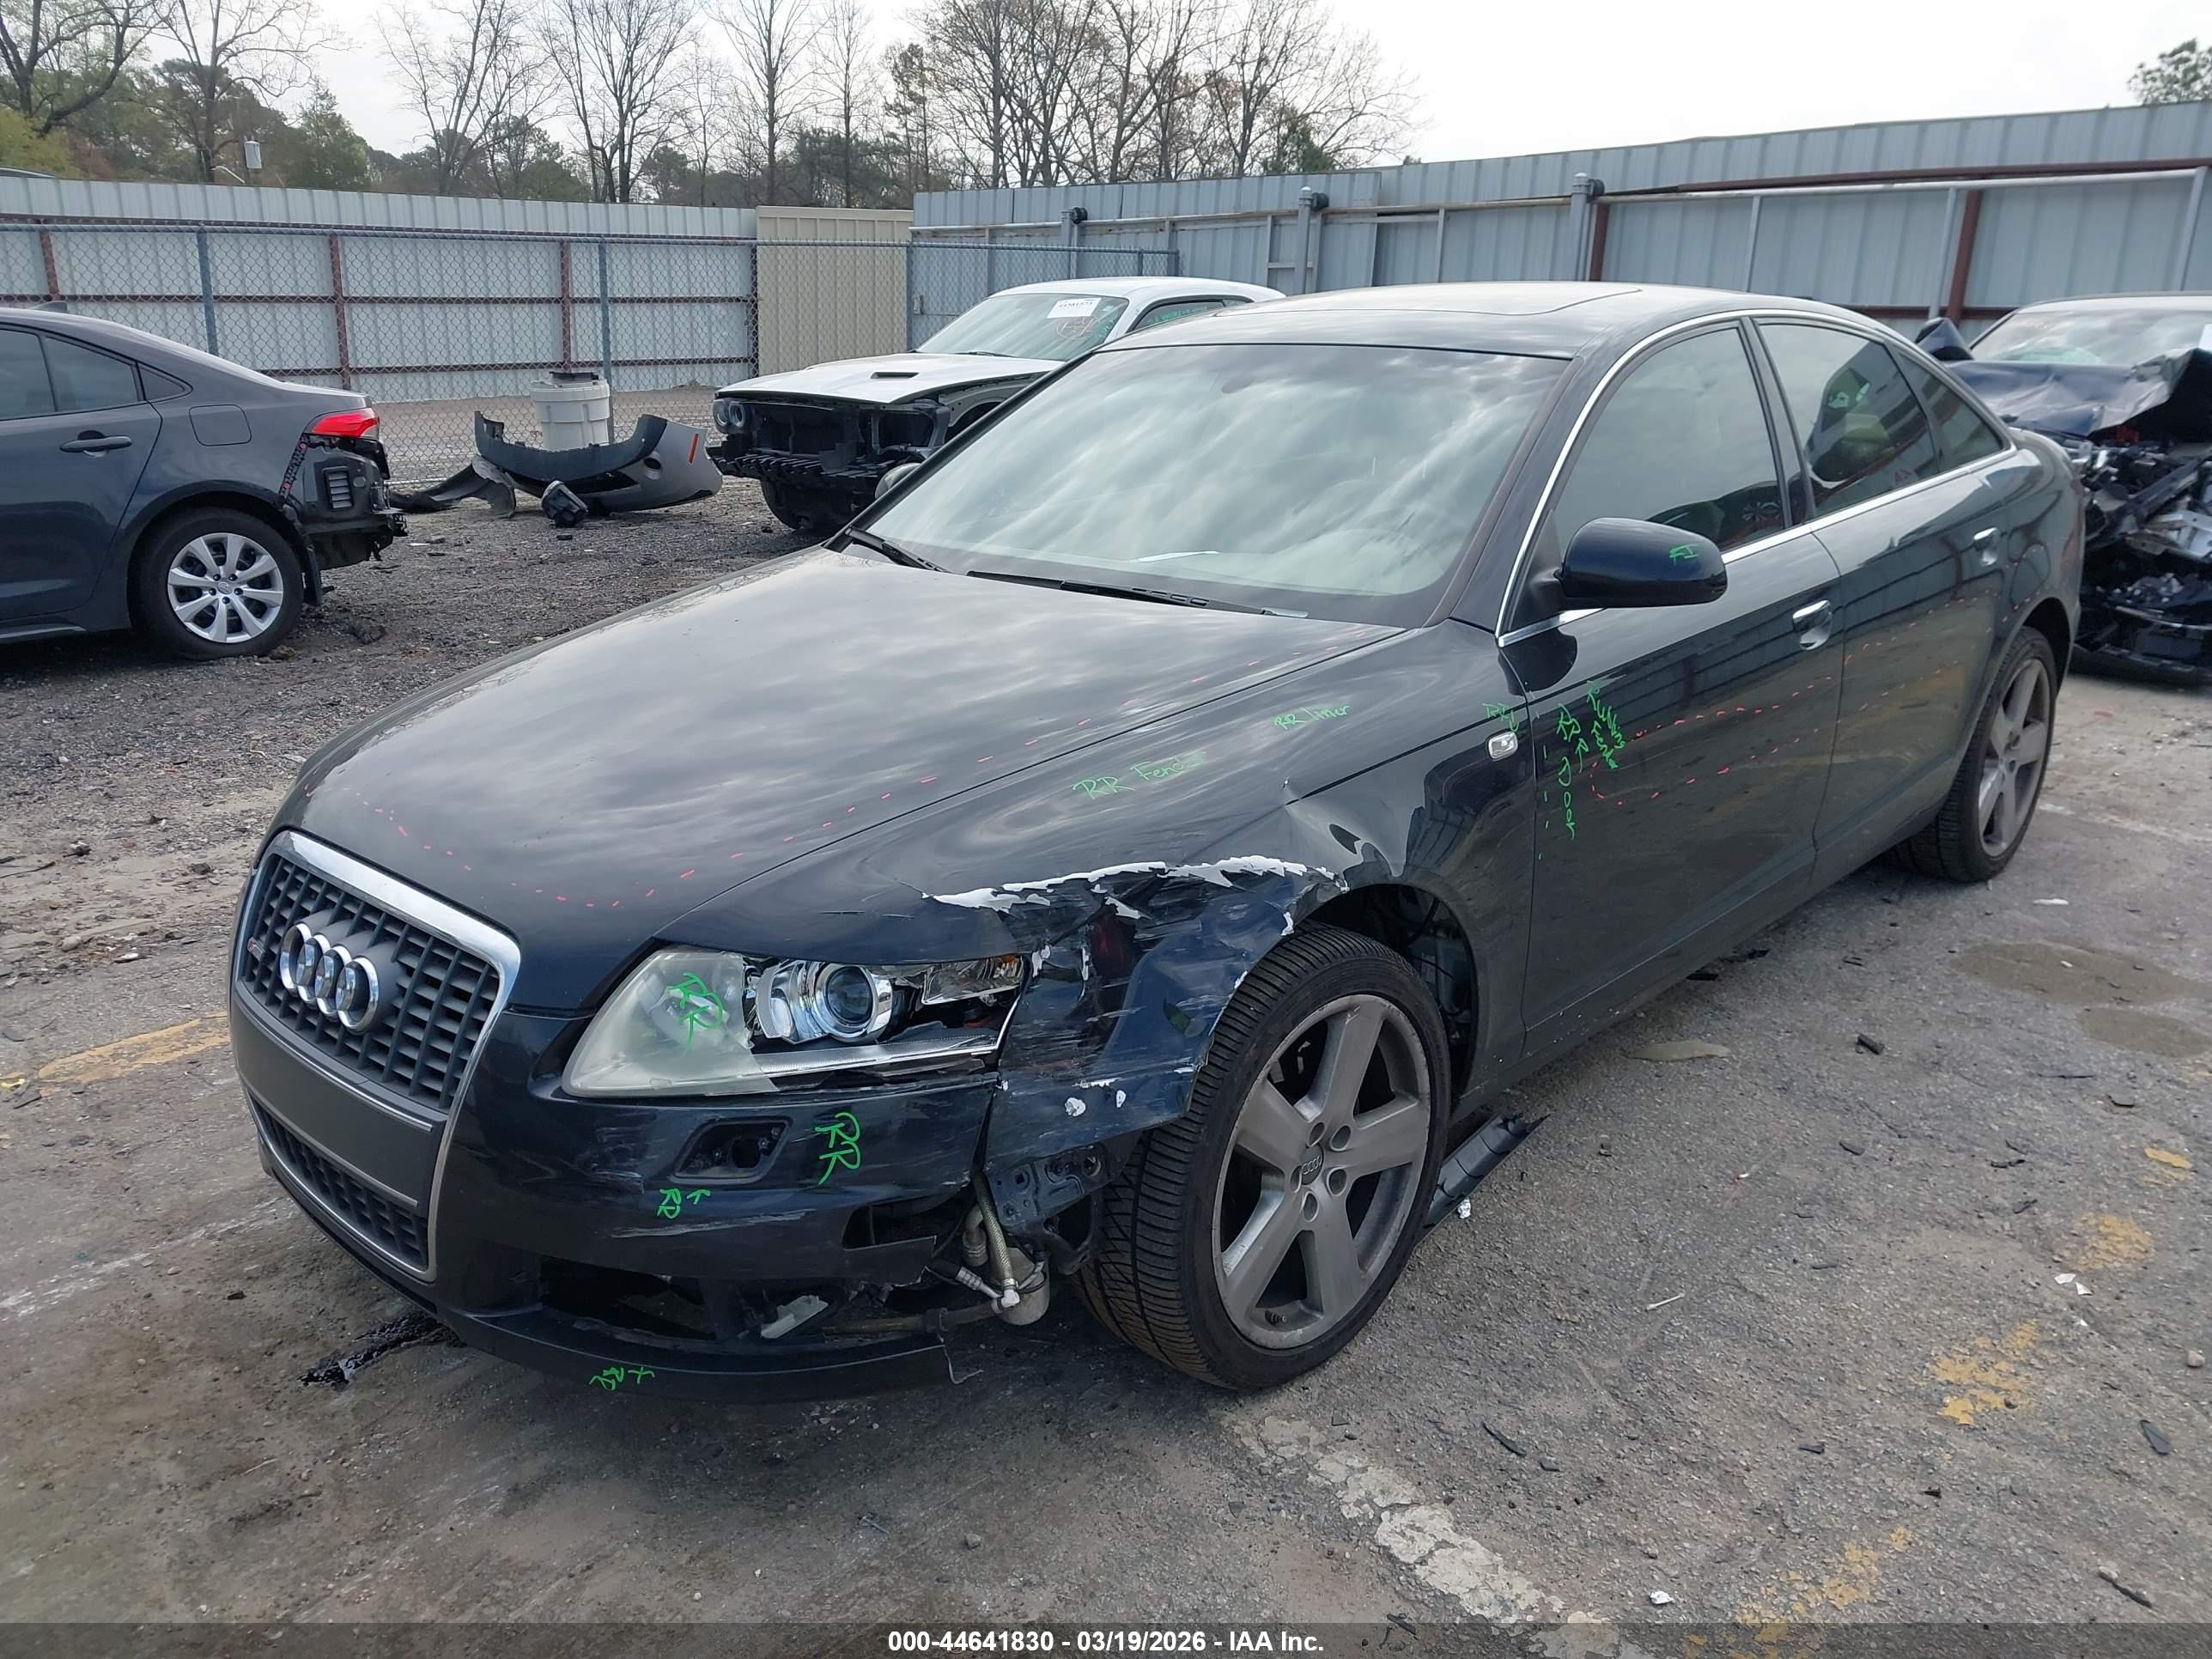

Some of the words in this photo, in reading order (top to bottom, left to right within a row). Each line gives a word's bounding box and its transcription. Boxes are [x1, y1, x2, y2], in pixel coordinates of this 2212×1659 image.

[1073, 776, 1135, 799] RR
[666, 972, 723, 1044] RR
[815, 1112, 860, 1186] RR
